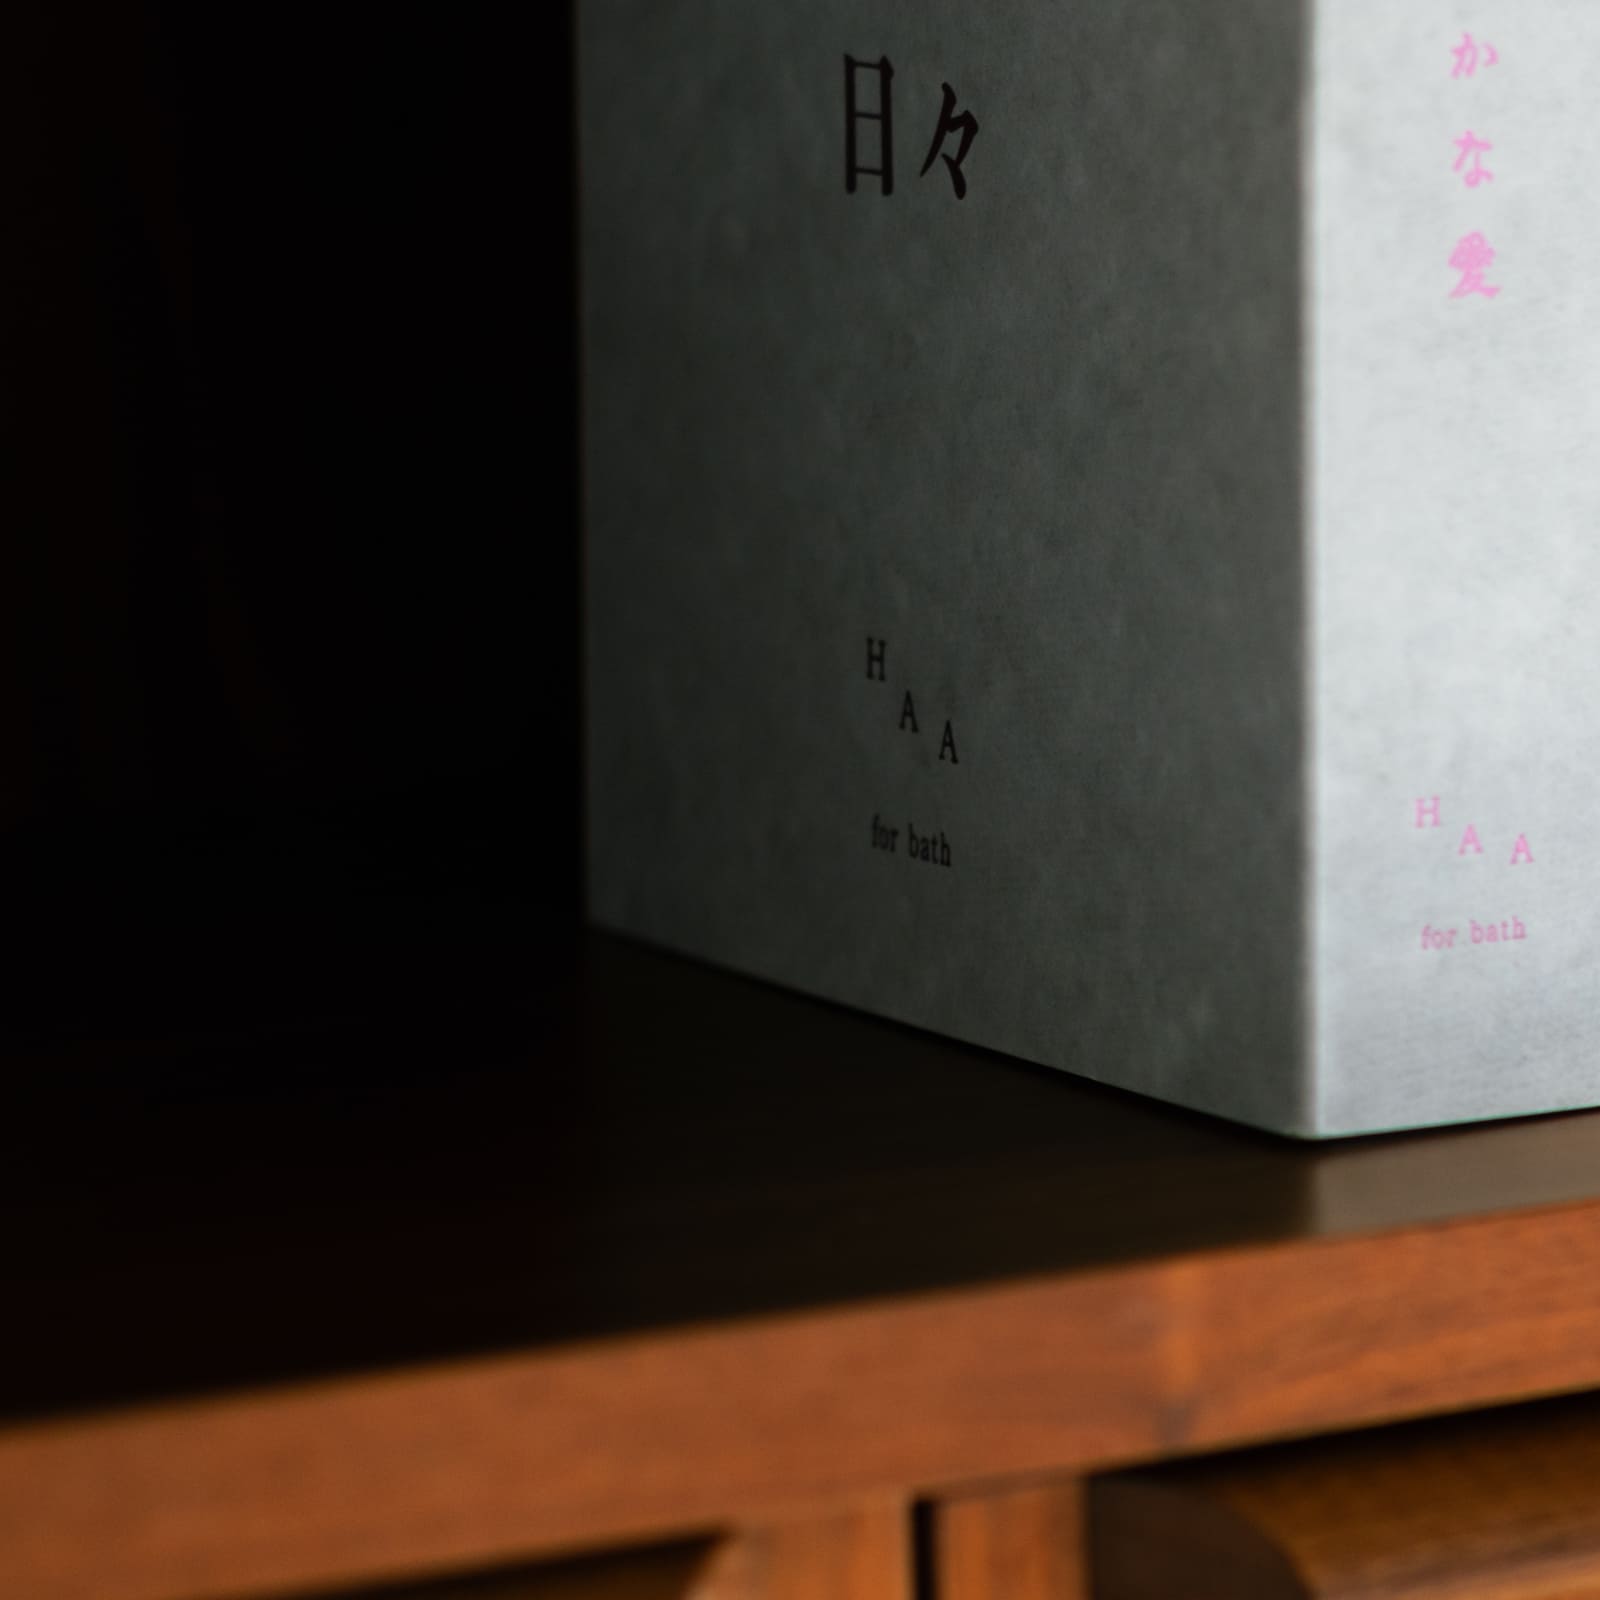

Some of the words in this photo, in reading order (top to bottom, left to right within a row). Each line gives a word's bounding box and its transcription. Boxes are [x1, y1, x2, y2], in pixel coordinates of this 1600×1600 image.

[844, 54, 979, 200] 日々
[870, 812, 899, 853] for
[907, 822, 952, 868] bath
[1420, 924, 1457, 951] for
[1469, 916, 1527, 945] bath
